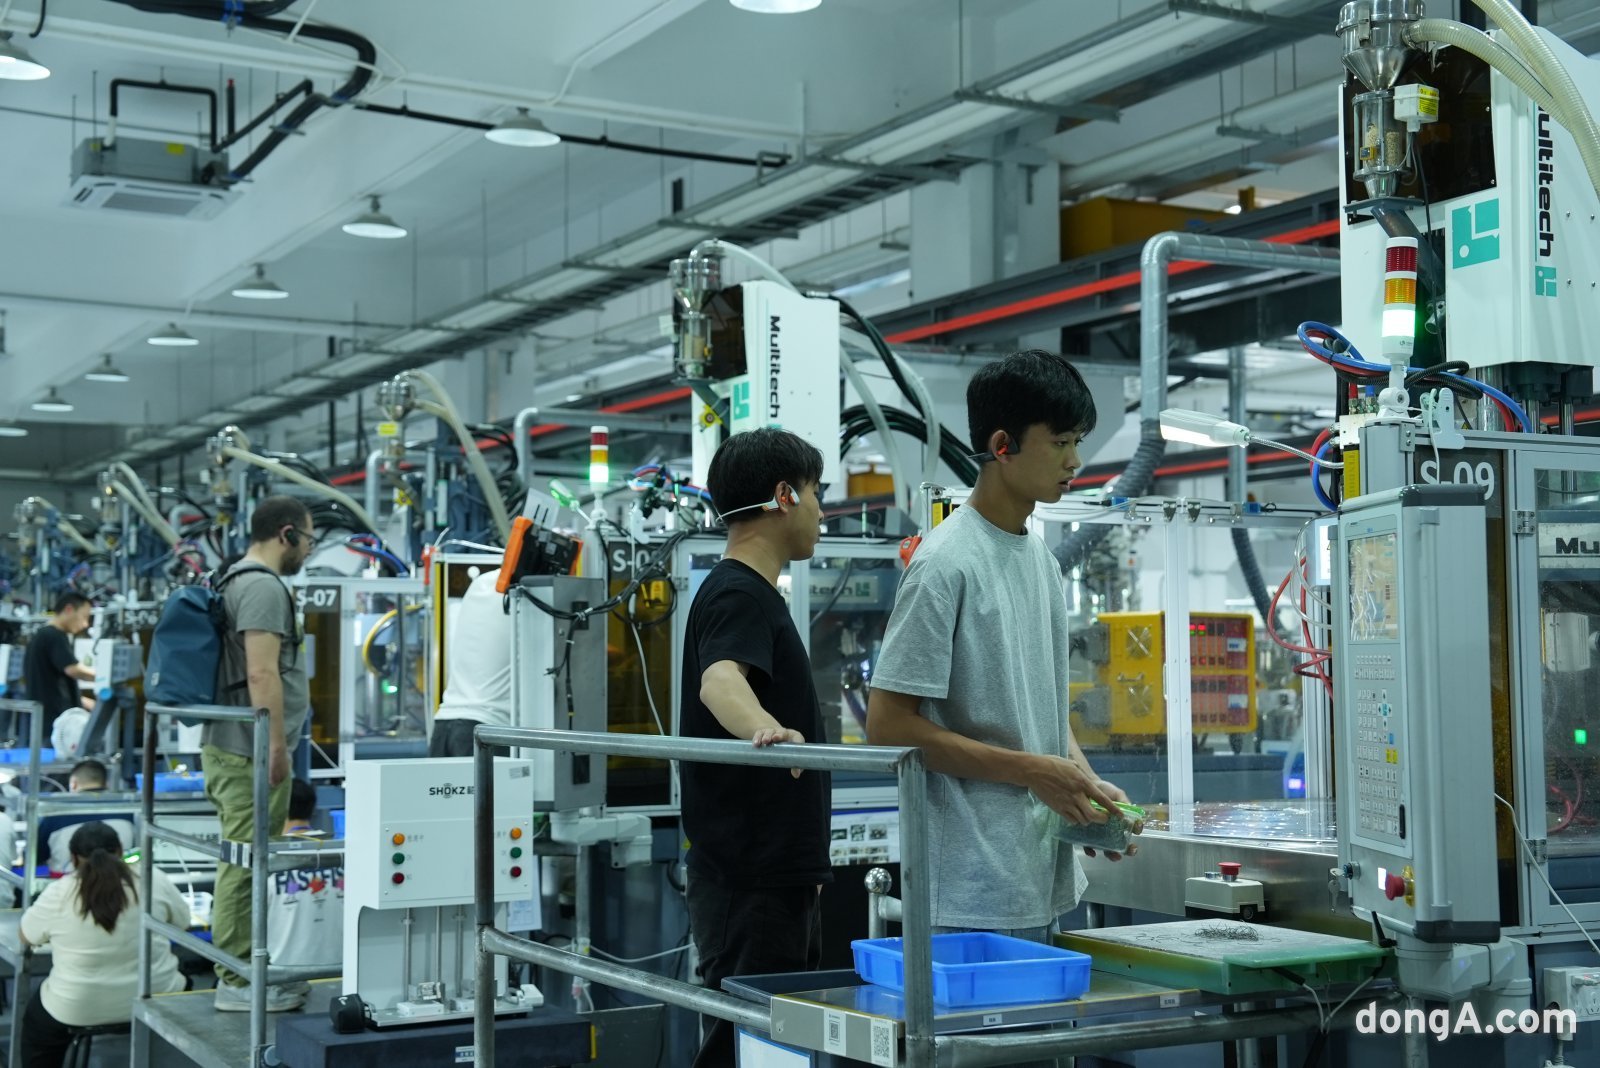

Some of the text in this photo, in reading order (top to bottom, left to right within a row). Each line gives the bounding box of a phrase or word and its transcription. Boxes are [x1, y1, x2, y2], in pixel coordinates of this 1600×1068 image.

[1538, 105, 1554, 257] ultitech
[770, 315, 781, 418] Multitech
[296, 589, 337, 606] S-07
[429, 785, 465, 796] SHOKZ
